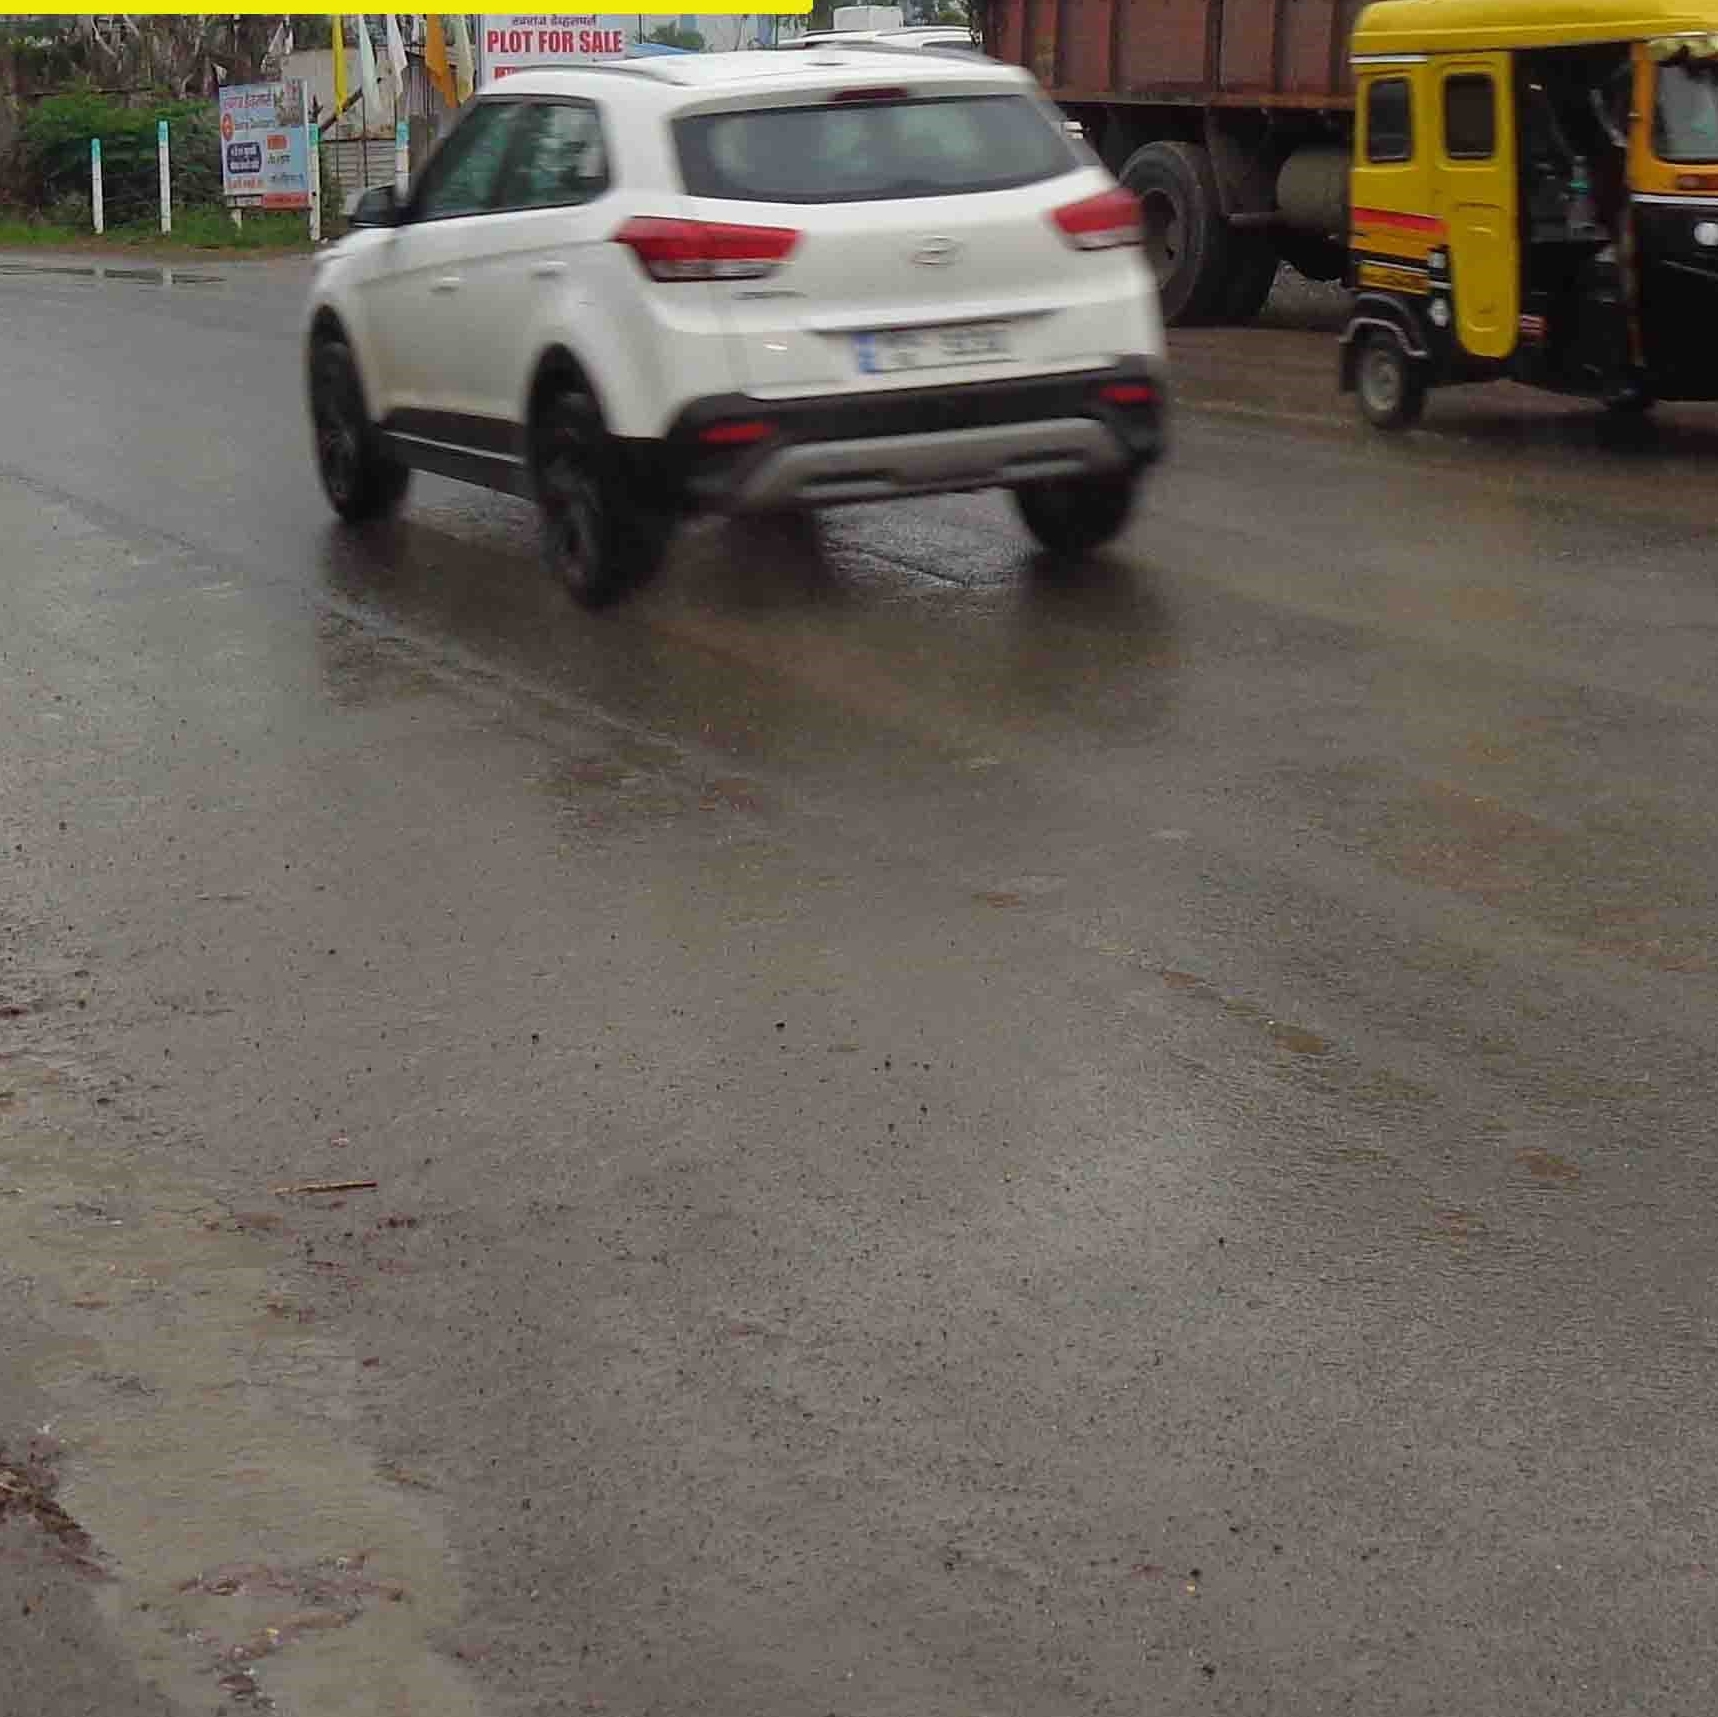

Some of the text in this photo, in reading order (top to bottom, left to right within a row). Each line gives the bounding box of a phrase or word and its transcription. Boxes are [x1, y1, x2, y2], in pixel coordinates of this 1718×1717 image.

[488, 30, 624, 53] PLOT FOR SALE
